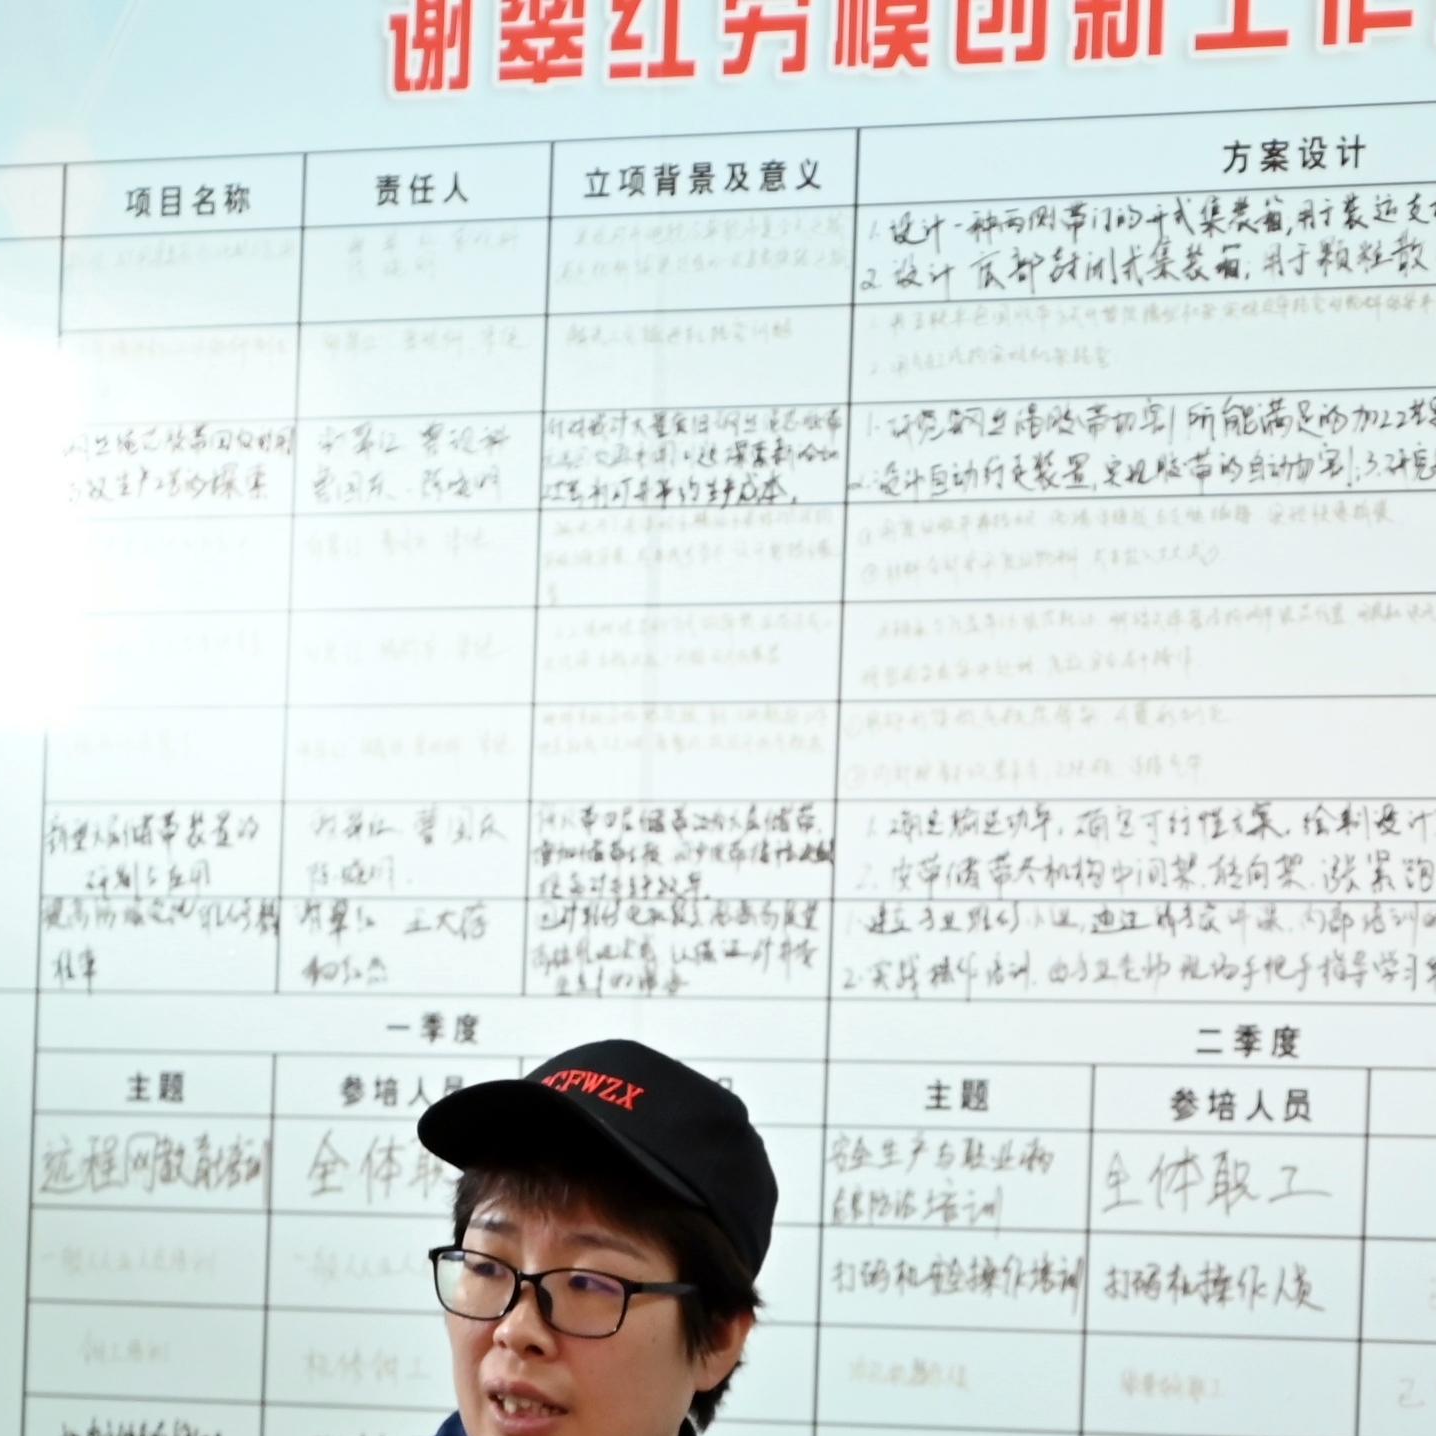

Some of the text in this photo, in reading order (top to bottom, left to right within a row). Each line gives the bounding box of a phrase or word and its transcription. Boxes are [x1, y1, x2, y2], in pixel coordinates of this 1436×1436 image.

[1221, 135, 1368, 175] 方案设计
[375, 170, 470, 207] 责任人
[584, 158, 824, 198] 立项背景及意义
[125, 182, 252, 219] 项目名称
[387, 1012, 479, 1045] 一季度
[1195, 1025, 1301, 1059] 二季度
[127, 1071, 185, 1103] 主题
[340, 1074, 463, 1109] 参培人员
[925, 1078, 989, 1112] 主题
[1170, 1088, 1313, 1123] 参培人员
